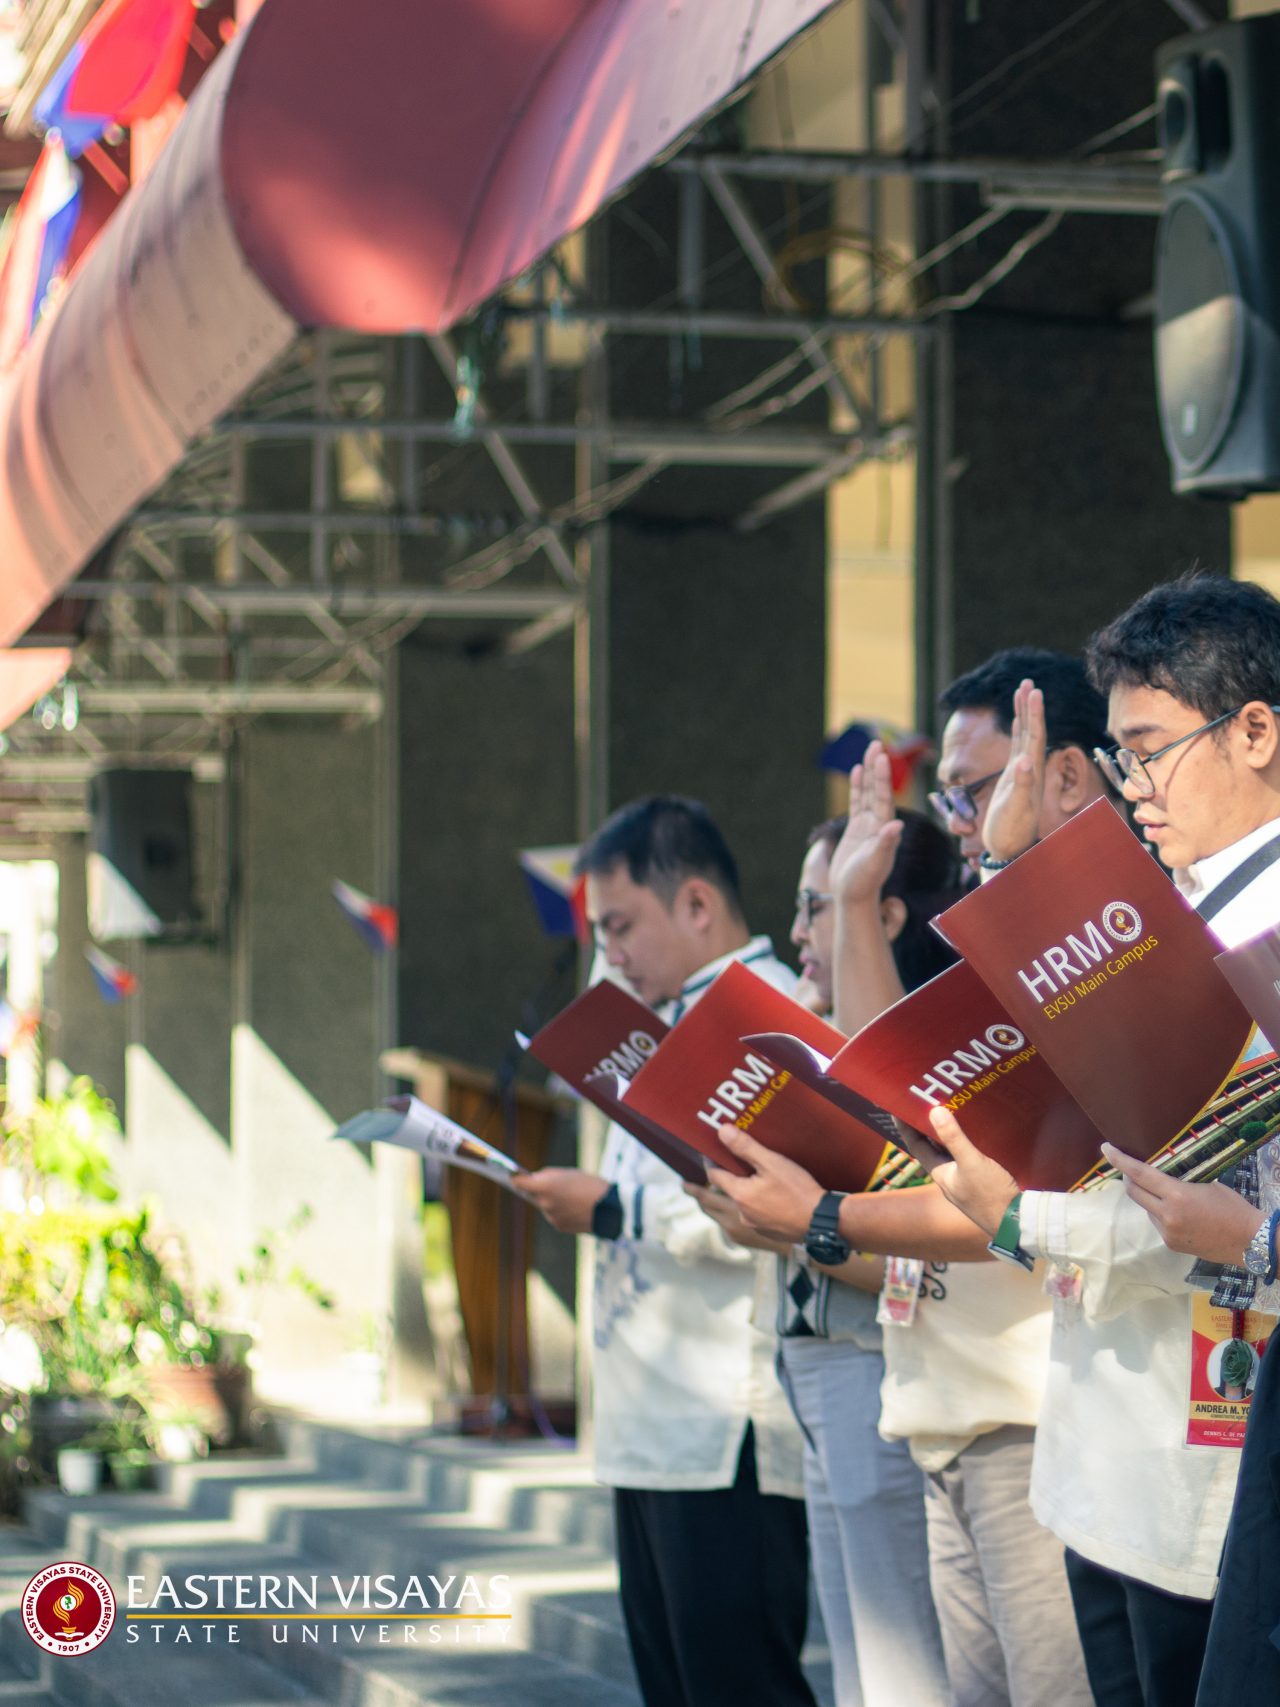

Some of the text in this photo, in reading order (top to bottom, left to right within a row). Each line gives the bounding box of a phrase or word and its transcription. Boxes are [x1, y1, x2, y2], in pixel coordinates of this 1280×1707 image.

[1043, 935, 1159, 1020] EVSU Main Campus
[748, 1088, 776, 1115] Main
[944, 1089, 972, 1115] VSU
[969, 1070, 1001, 1093] Main
[1195, 1404, 1228, 1414] ANDREA
[1230, 1405, 1239, 1414] M.
